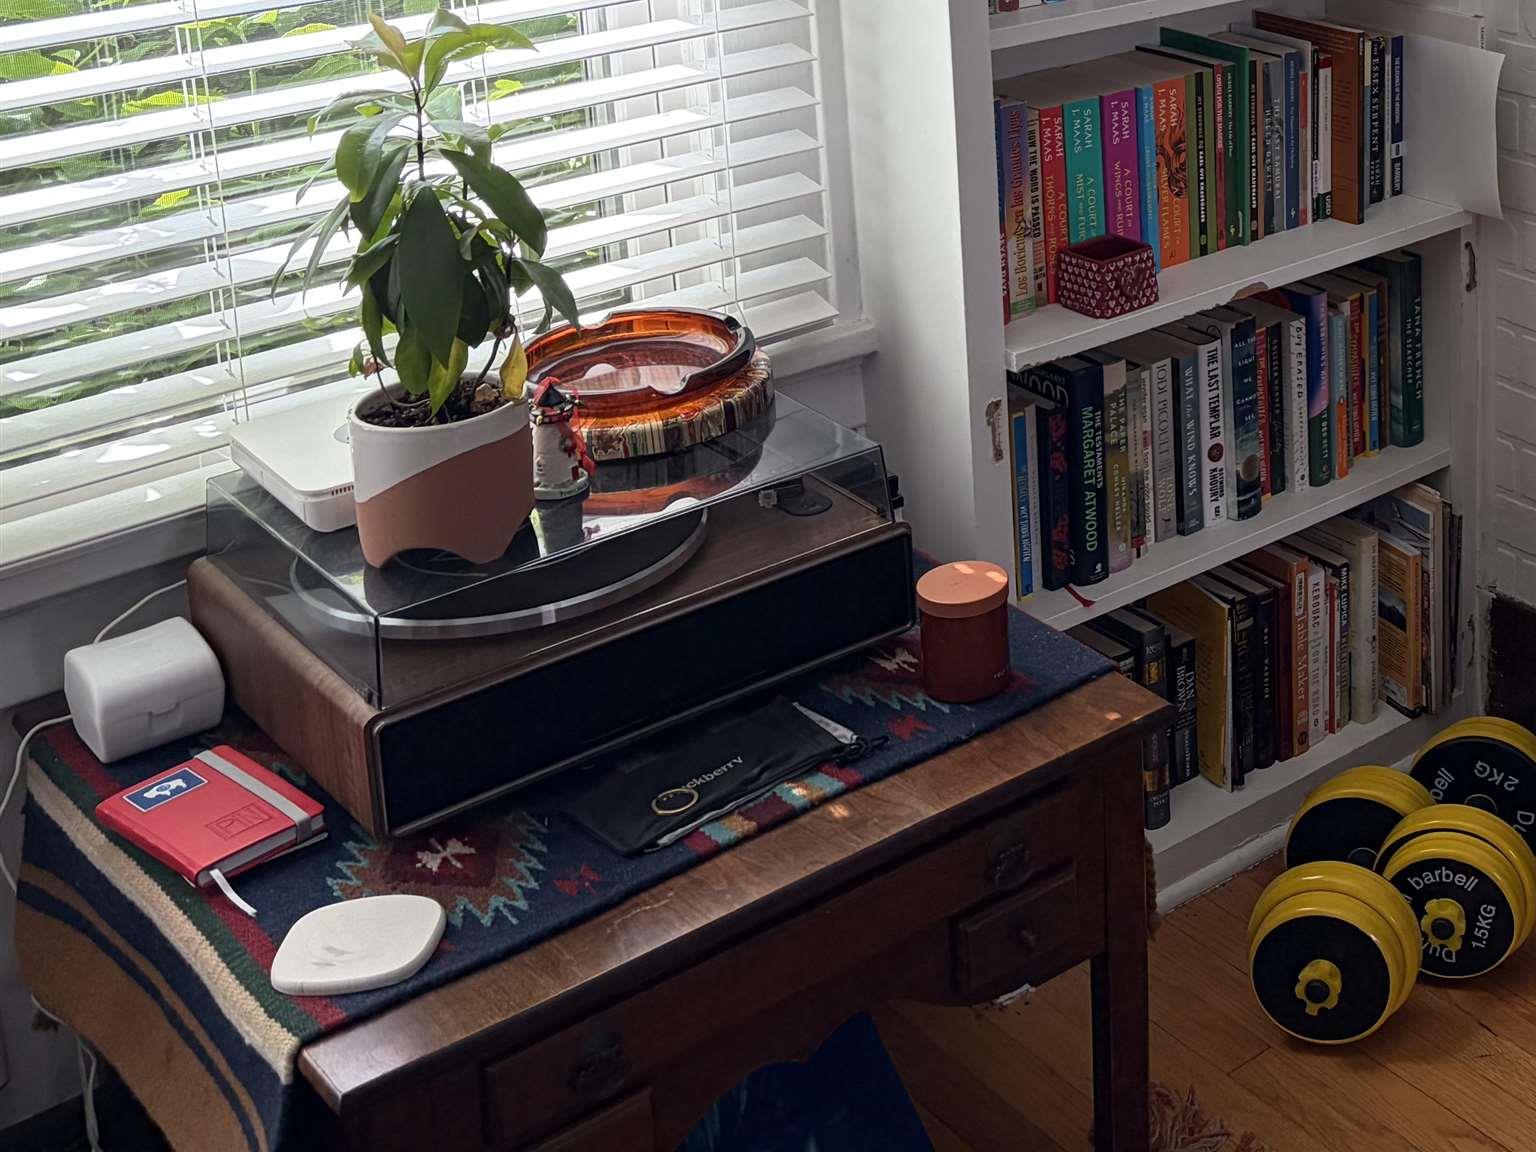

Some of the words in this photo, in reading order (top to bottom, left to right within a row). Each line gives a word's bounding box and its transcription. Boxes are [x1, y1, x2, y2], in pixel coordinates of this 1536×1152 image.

[1082, 107, 1093, 149] SARAH
[1120, 101, 1130, 140] SARAH
[1207, 347, 1218, 366] THE
[1156, 363, 1169, 394] JODI
[1208, 368, 1220, 395] LAST
[1157, 398, 1170, 456] PICOULT
[1209, 397, 1221, 440] TEMPLAR
[1080, 406, 1096, 486] MARGARET
[1084, 491, 1099, 552] ATWOOD
[1312, 581, 1321, 629] KEROUAC
[1176, 665, 1187, 713] BROWN
[1185, 671, 1196, 699] DAN
[686, 755, 743, 789] ckberry
[1473, 759, 1520, 792] 2KG
[1407, 865, 1479, 893] barbell
[1470, 903, 1497, 950] 1.5KG
